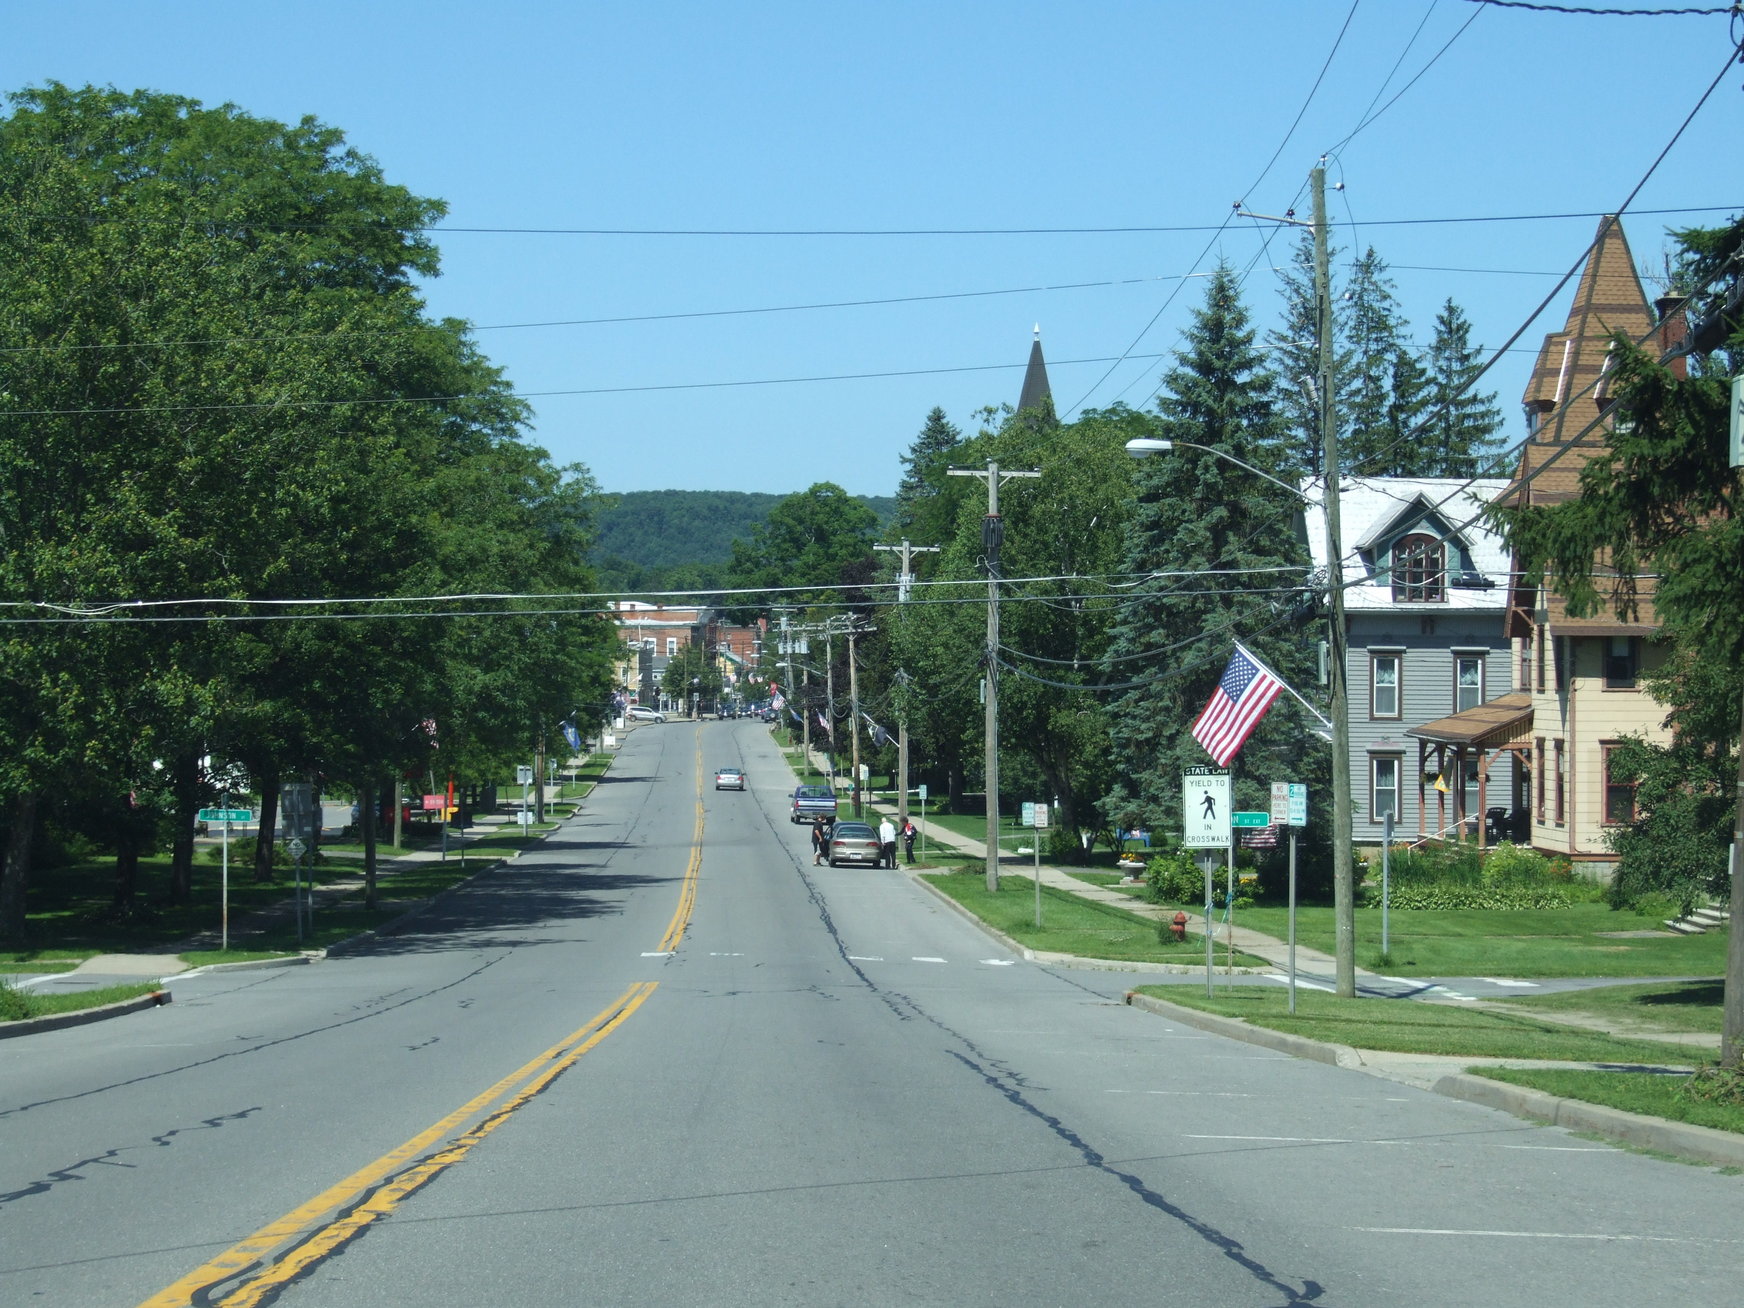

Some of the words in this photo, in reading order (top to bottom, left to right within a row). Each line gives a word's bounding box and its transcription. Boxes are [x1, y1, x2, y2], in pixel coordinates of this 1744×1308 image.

[1185, 767, 1210, 775] STATE
[1276, 785, 1284, 793] NO
[1271, 794, 1289, 802] PARKING
